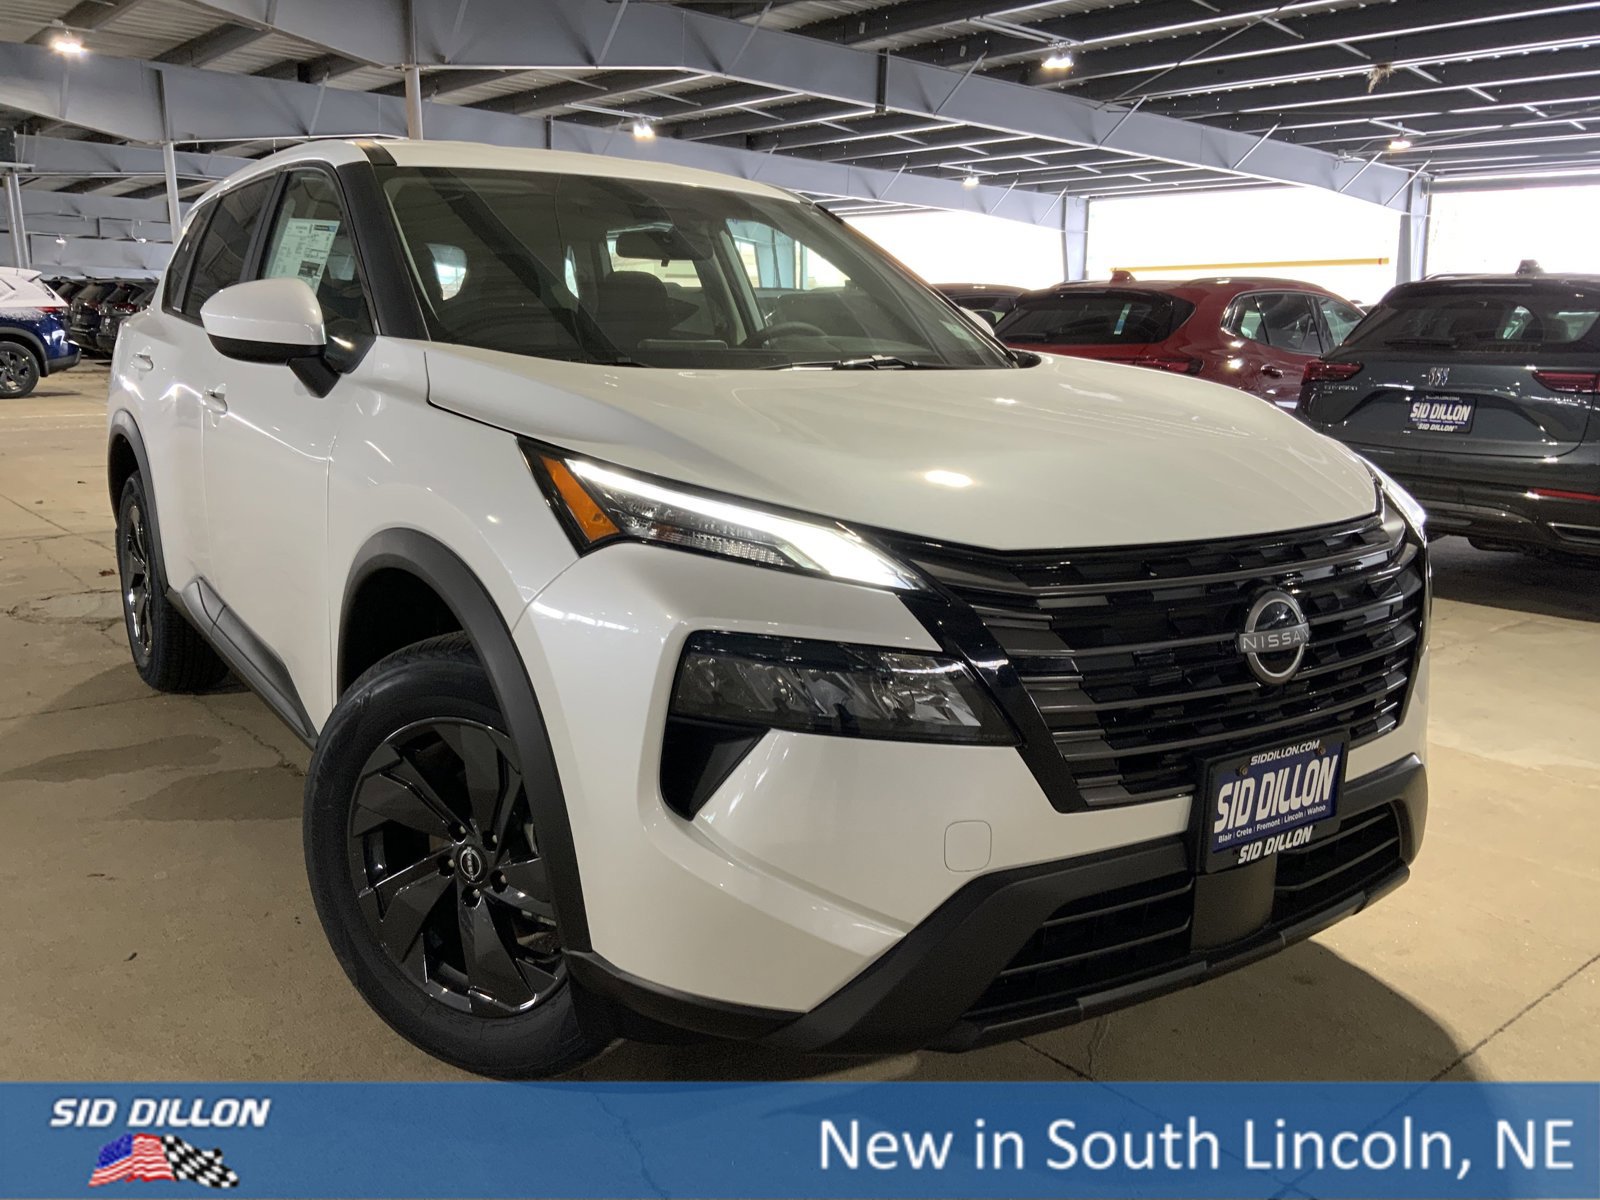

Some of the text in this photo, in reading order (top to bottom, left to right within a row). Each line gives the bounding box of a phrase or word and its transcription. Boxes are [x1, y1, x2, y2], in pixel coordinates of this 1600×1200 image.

[1410, 402, 1471, 422] SID DILLON
[1250, 740, 1320, 766] SIDDILLON.COM
[1214, 755, 1338, 833] SID DILLON
[1218, 804, 1326, 843] Blair Crete Fremont Lincoln Wahoo
[1238, 825, 1313, 864] SID DILLON
